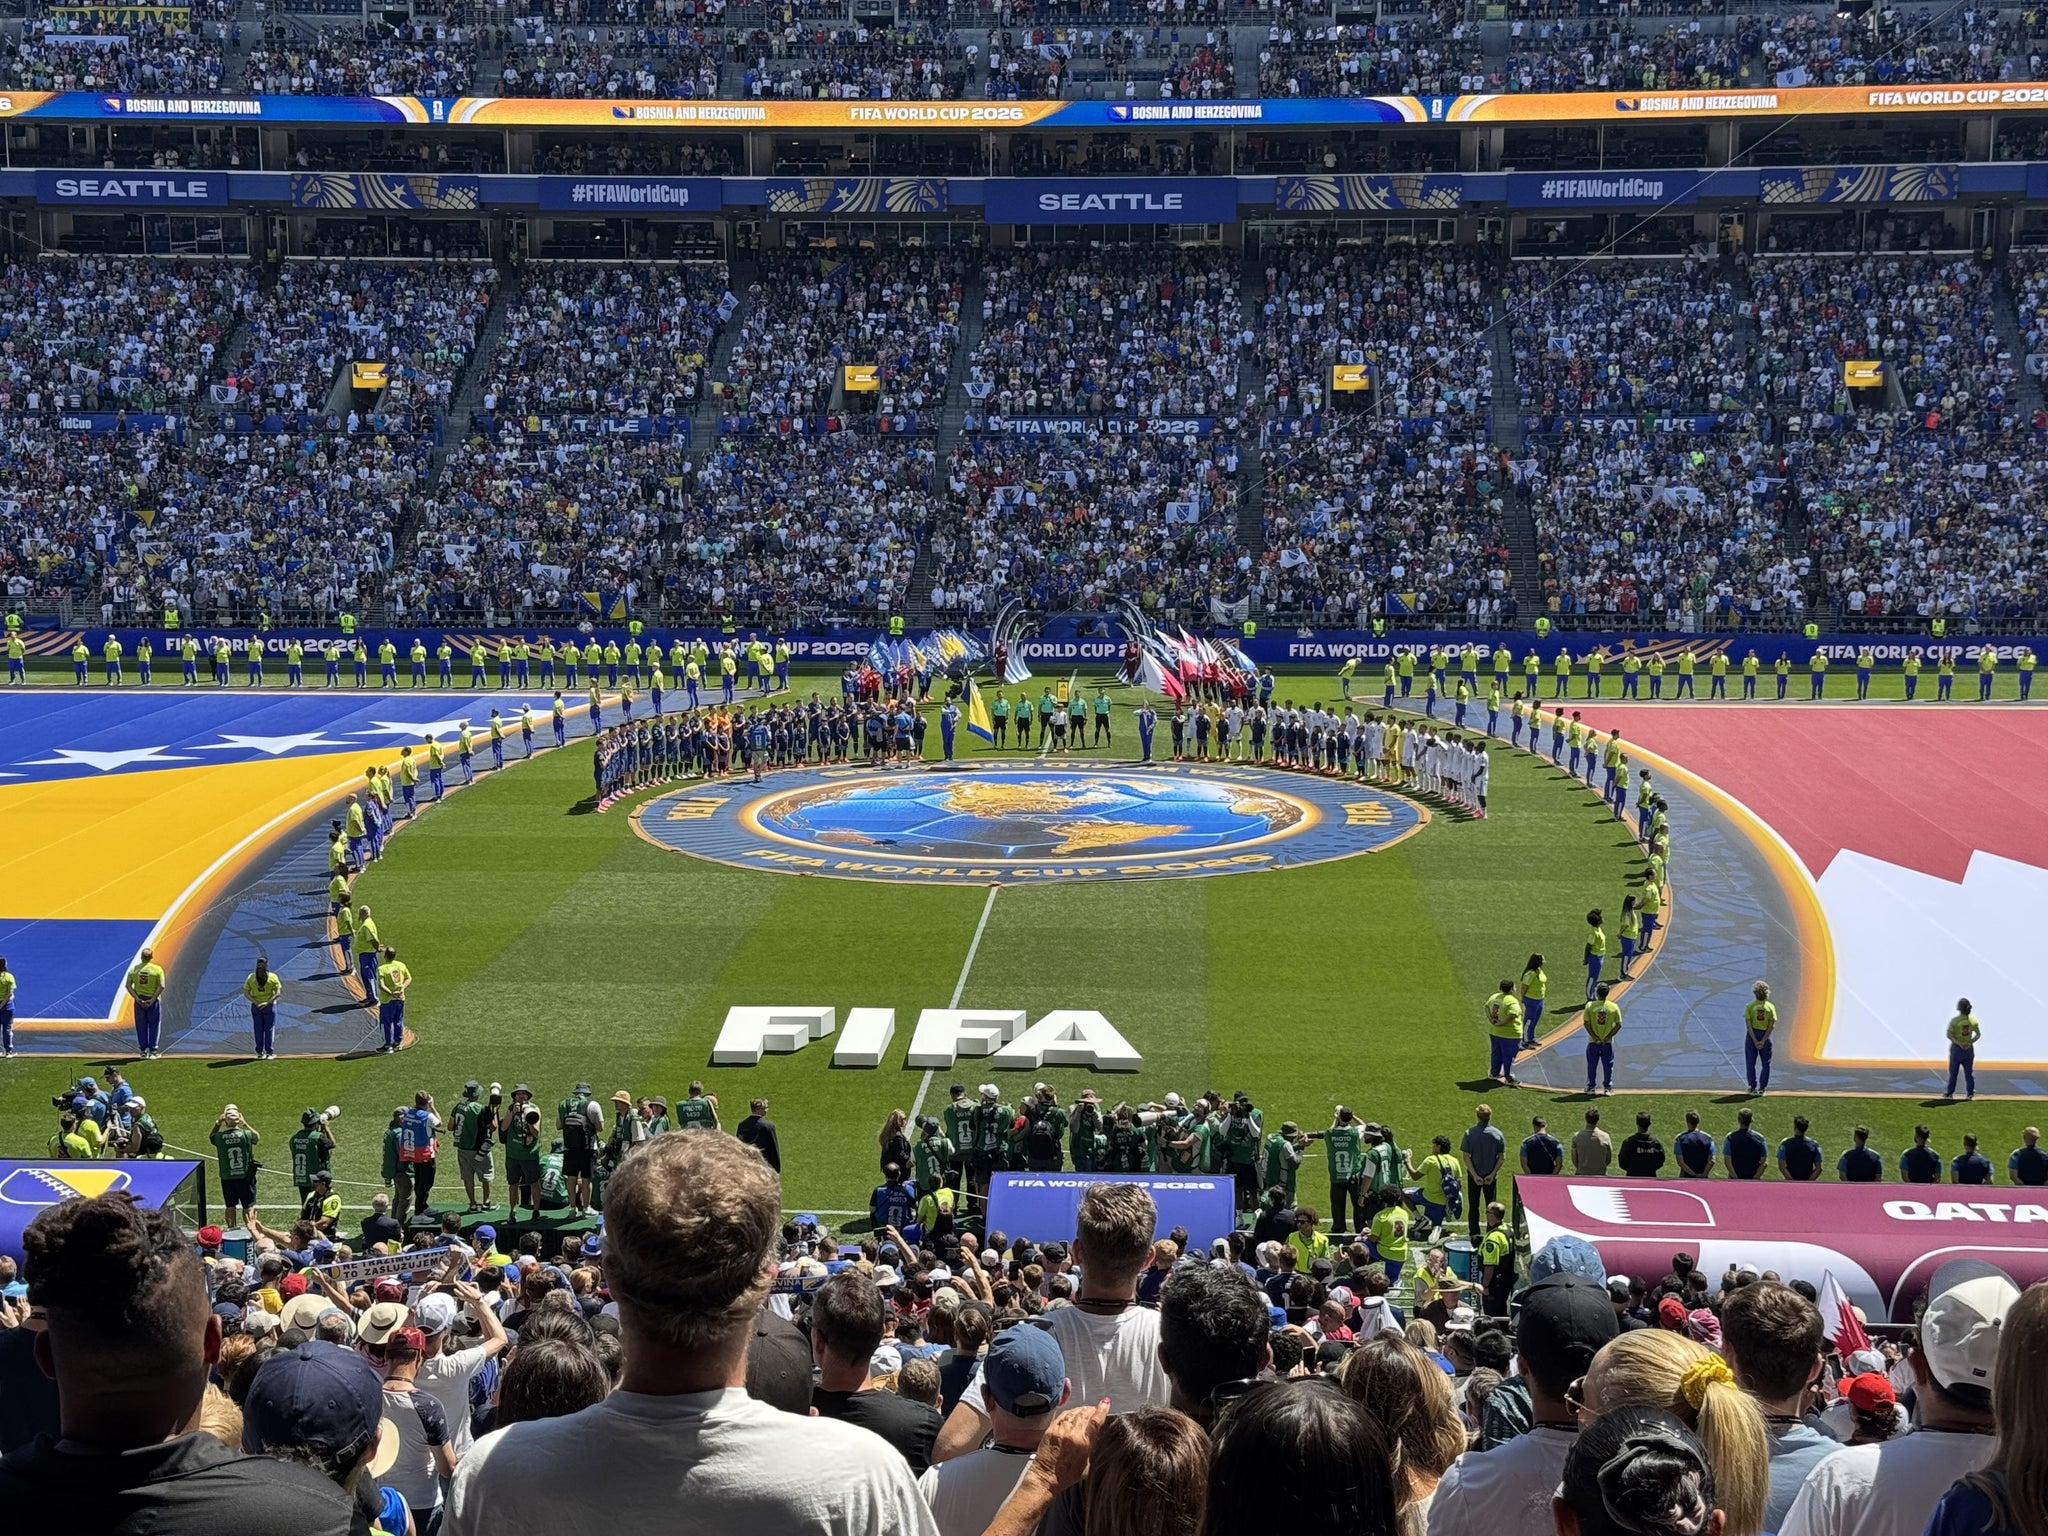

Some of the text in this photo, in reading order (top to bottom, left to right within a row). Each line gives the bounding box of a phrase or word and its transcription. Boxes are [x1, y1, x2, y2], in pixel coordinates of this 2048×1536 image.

[857, 1, 892, 10] 308
[1640, 95, 1777, 111] BOSNIA AND HERZEGOVINA
[1869, 92, 1903, 105] FIFA
[1905, 91, 1966, 104] WORLD
[1966, 90, 2000, 103] CUP
[126, 99, 262, 114] BOSNIA AND HERZEGOVINA
[636, 106, 766, 120] BOSNIA AND HERZEGOVINA
[1132, 105, 1262, 119] BOSNIA AND HERZEGOVINA
[851, 108, 1023, 120] FIFA WORLD CUP 2026
[55, 179, 208, 198] SEATTLE
[572, 184, 689, 206] #FIFAWorldCup
[1541, 178, 1663, 200] #FIFAWorldCup
[1039, 193, 1183, 211] SEATTLE
[1008, 421, 1041, 433] FIFA
[811, 642, 870, 655] 2026
[1080, 643, 1116, 657] CUP
[1289, 644, 1325, 657] FIFA
[1327, 644, 1390, 657] WORLD
[1818, 645, 1856, 659] FIFA
[1340, 801, 1393, 826] FIFA
[741, 850, 1274, 877] FIFA WORLD CUP 2026
[713, 1006, 1142, 1071] FIFA
[1008, 1179, 1046, 1188] FIFA
[1152, 1182, 1216, 1190] 2026
[343, 1270, 358, 1279] TO
